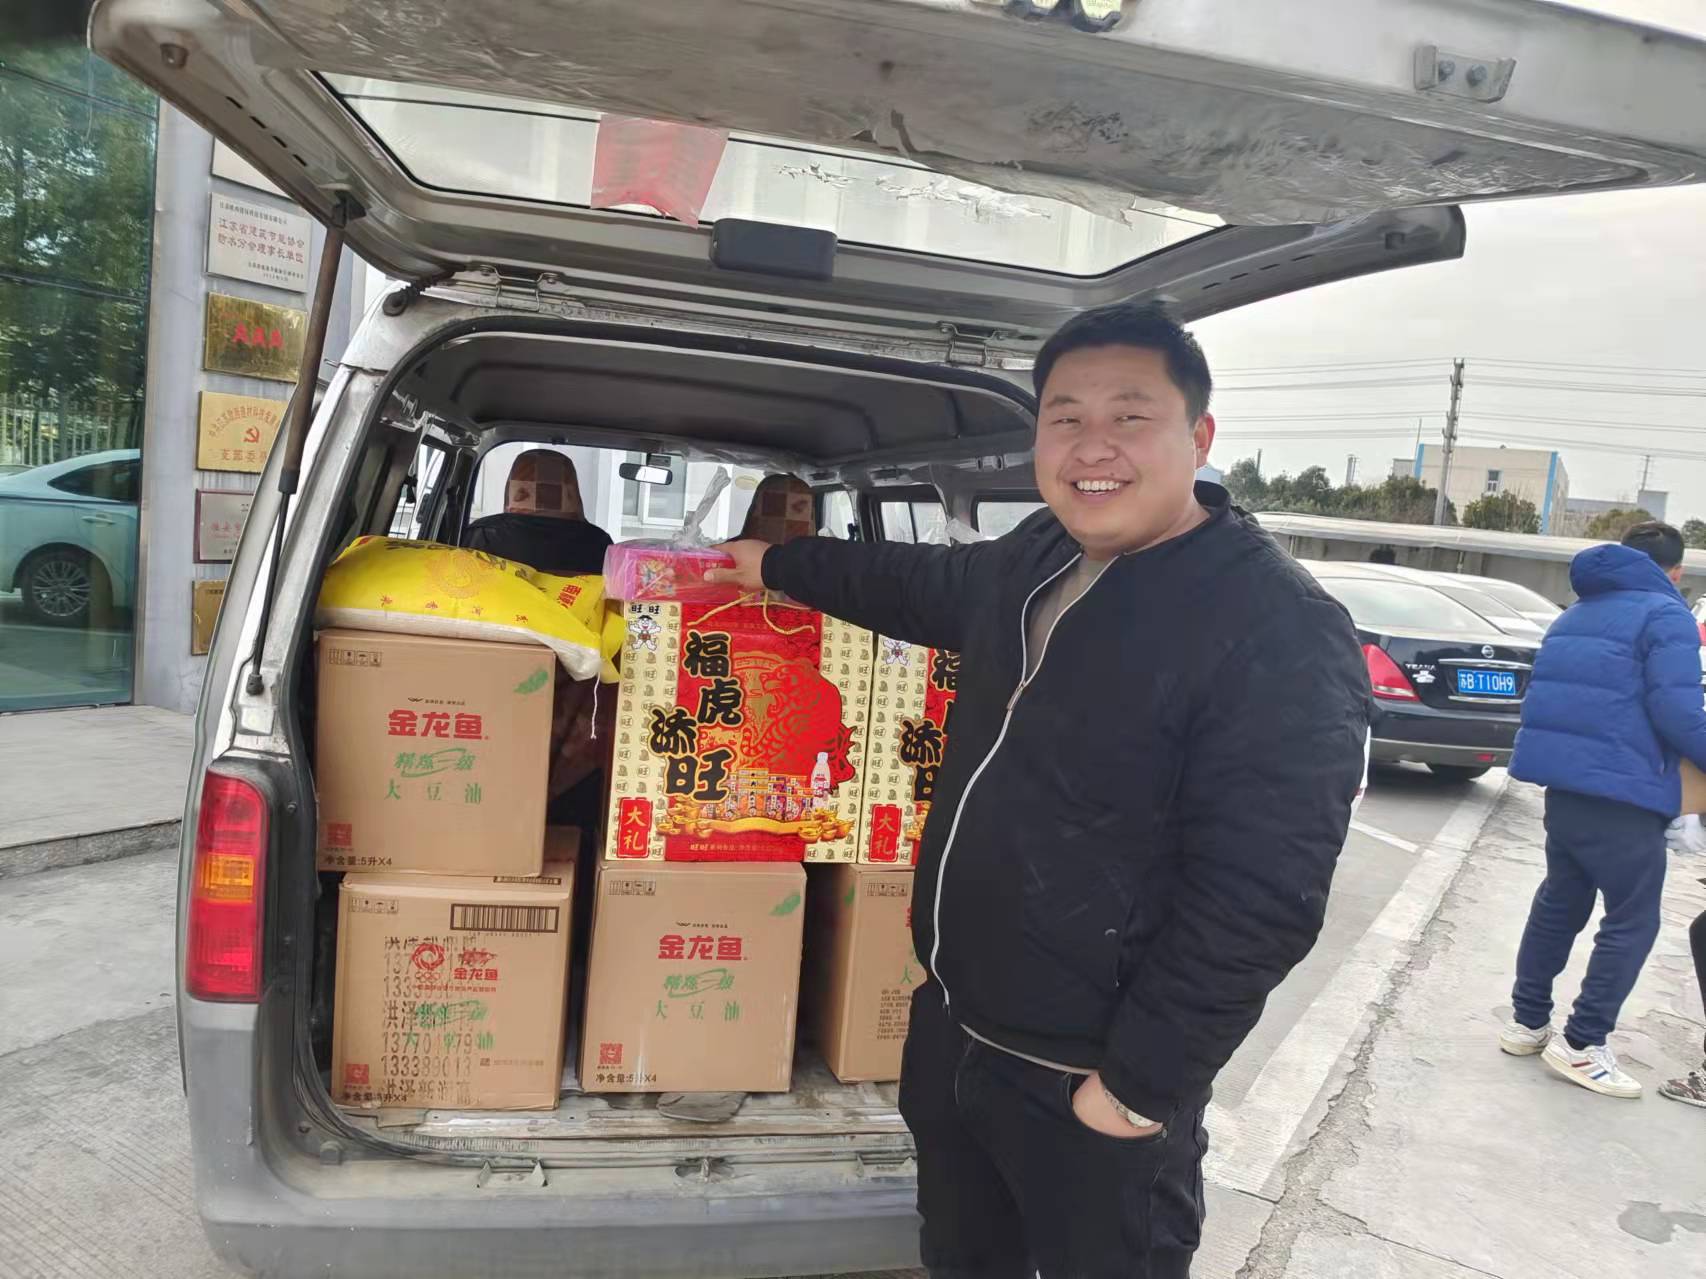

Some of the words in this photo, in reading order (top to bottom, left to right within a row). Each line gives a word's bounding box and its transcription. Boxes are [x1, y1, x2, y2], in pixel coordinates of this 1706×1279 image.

[631, 603, 661, 615] 旺旺
[388, 709, 483, 740] 金龙鱼
[385, 779, 483, 805] 大豆油
[624, 805, 648, 852] 大礼
[876, 813, 897, 856] 大礼
[658, 935, 743, 961] 金龙鱼
[656, 1000, 741, 1022] 大豆油
